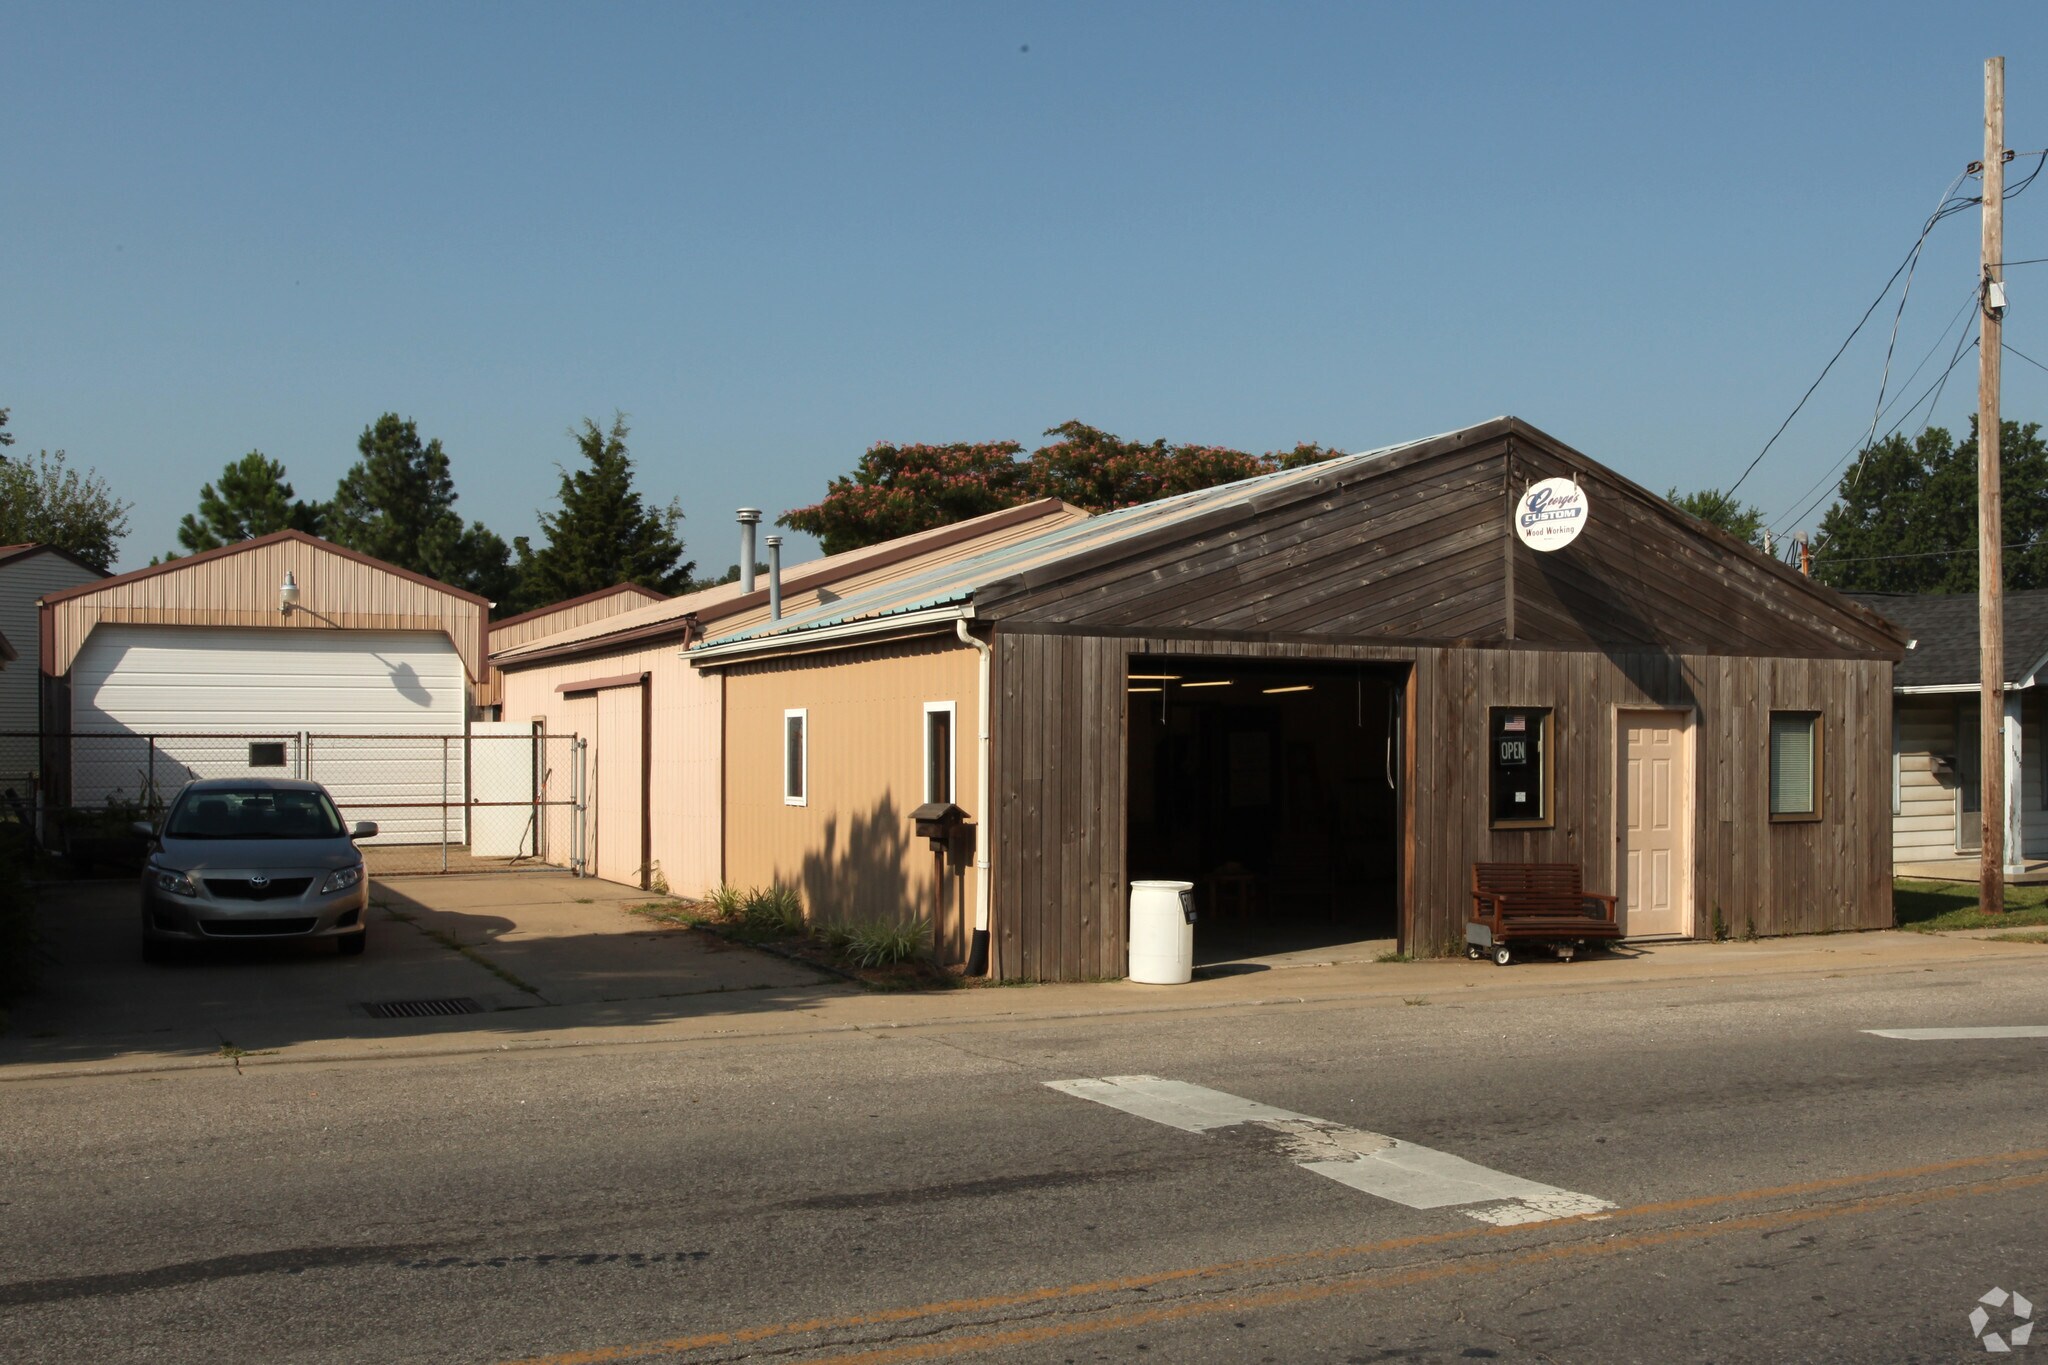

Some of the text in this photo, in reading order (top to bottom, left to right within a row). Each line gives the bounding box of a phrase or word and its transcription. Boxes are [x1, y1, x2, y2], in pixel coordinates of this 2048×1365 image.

[1526, 487, 1579, 513] George's
[1524, 509, 1576, 522] CUSTOM
[1526, 526, 1574, 536] Wood Working
[1501, 741, 1525, 759] OPEN
